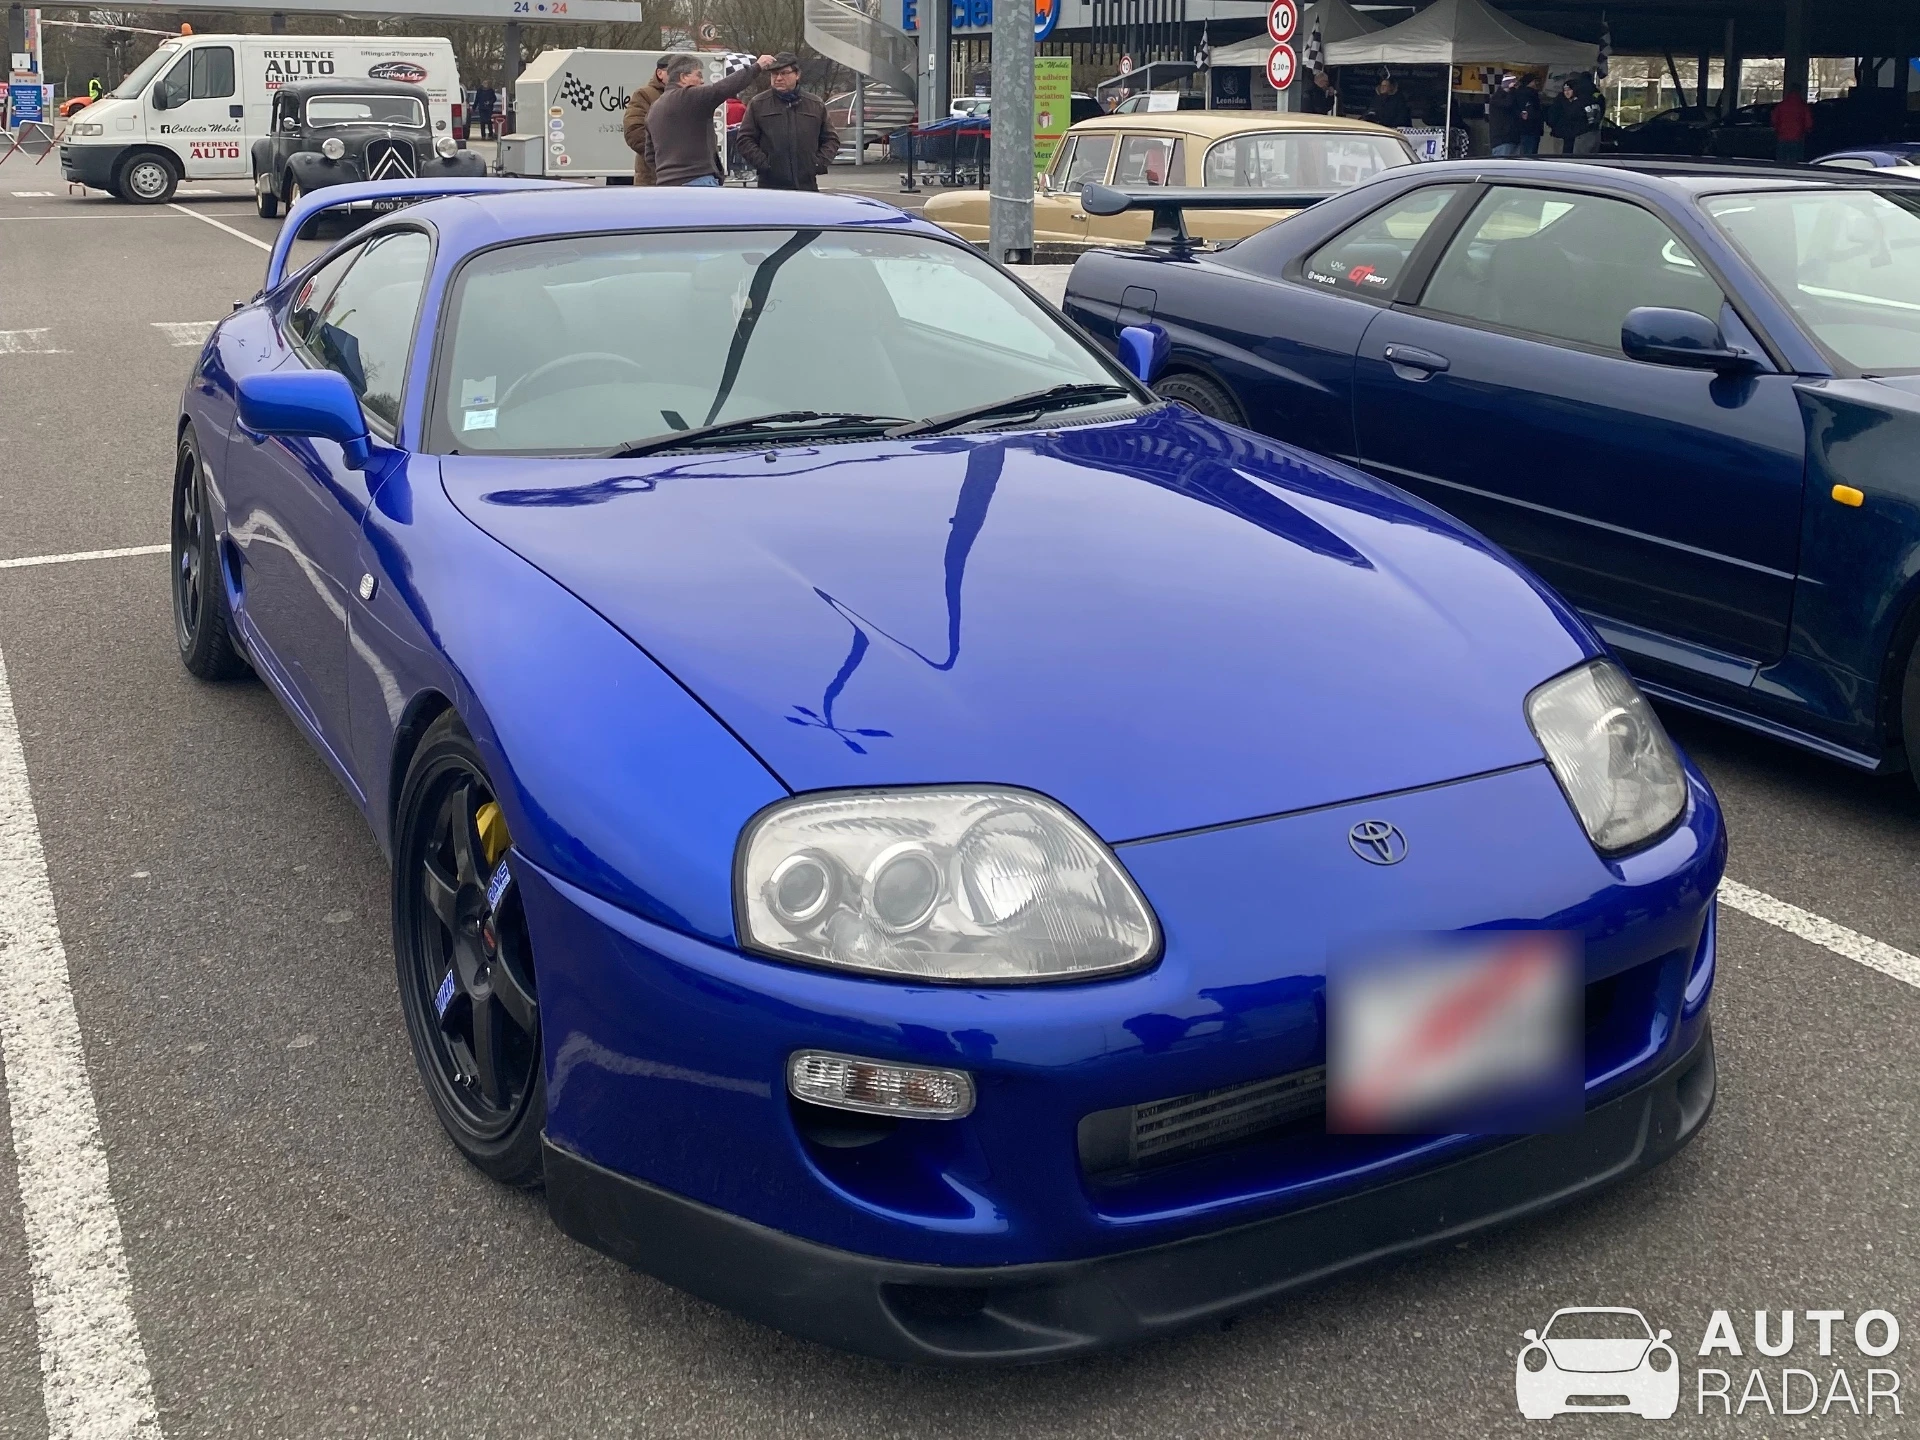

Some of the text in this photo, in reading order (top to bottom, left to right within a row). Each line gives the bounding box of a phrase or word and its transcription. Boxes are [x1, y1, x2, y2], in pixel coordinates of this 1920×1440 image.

[514, 2, 567, 14] 24 24
[1274, 11, 1289, 29] 10
[263, 51, 335, 59] REFERENCE
[265, 60, 335, 74] AUTO
[1122, 62, 1130, 71] 10
[380, 70, 420, 80] Lifting Car
[1216, 96, 1247, 105] Leonidas
[171, 124, 207, 134] Collecto
[207, 124, 241, 133] Mobile
[190, 148, 239, 159] AUTO
[374, 202, 394, 210] 4010
